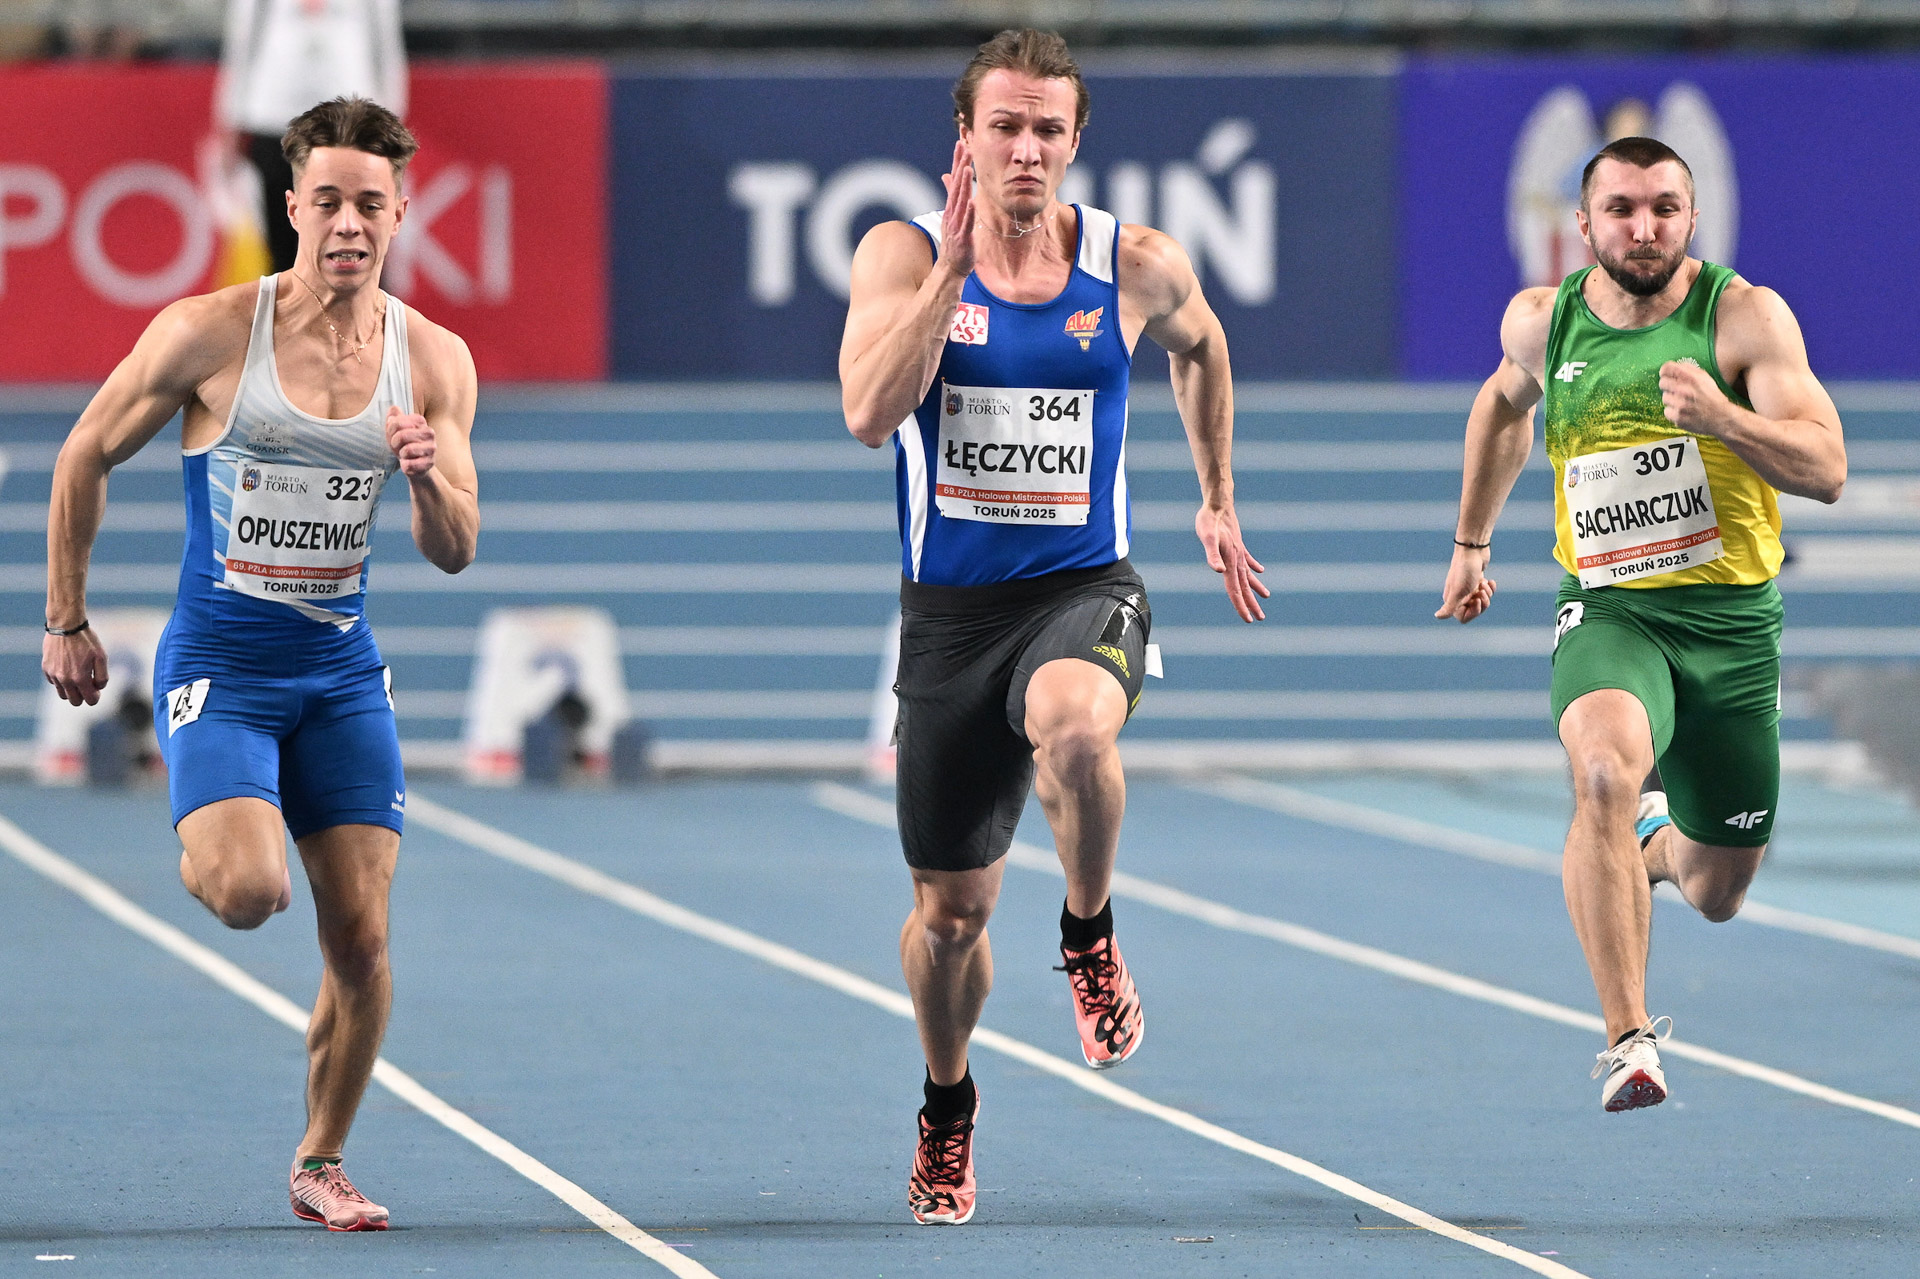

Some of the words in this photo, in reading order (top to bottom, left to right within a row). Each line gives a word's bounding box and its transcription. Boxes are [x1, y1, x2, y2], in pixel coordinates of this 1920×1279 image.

[729, 118, 1277, 305] TOŃ
[0, 160, 514, 306] POKI
[1554, 361, 1588, 383] 4F
[966, 403, 1012, 416] TORUŃ
[967, 397, 1003, 405] MIASTO
[1028, 395, 1081, 422] 364
[944, 439, 1086, 477] ŁĘCZYCKI
[1583, 462, 1609, 471] MIASTO
[1632, 443, 1685, 476] 307
[267, 473, 301, 482] MIASTO
[1582, 465, 1619, 482] TORUŃ
[264, 480, 309, 494] TORUŃ
[325, 476, 373, 501] 323
[943, 486, 957, 495] 69.
[958, 489, 977, 498] PZLA
[978, 491, 1011, 501] Halowe
[1012, 493, 1063, 503] Mistrzostwa
[1063, 494, 1086, 503] Polski
[973, 505, 1020, 518] TORUŃ
[1023, 508, 1056, 519] 2025
[1575, 486, 1709, 539] SACHARCZUK
[238, 515, 368, 551] OPUSZEWICZ
[1612, 549, 1642, 562] Halowe
[1643, 538, 1691, 555] Mistrzostwa
[1692, 529, 1716, 544] Polski
[233, 562, 246, 571] 69.
[248, 564, 268, 574] PZLA
[269, 567, 300, 577] Halowe
[1610, 557, 1655, 578] TORUŃ
[1657, 553, 1690, 569] 2025
[263, 581, 307, 593] TORUŃ
[310, 583, 339, 594] 2025
[1092, 645, 1131, 679] adidas
[172, 683, 194, 722] 4
[1725, 810, 1769, 829] 4F
